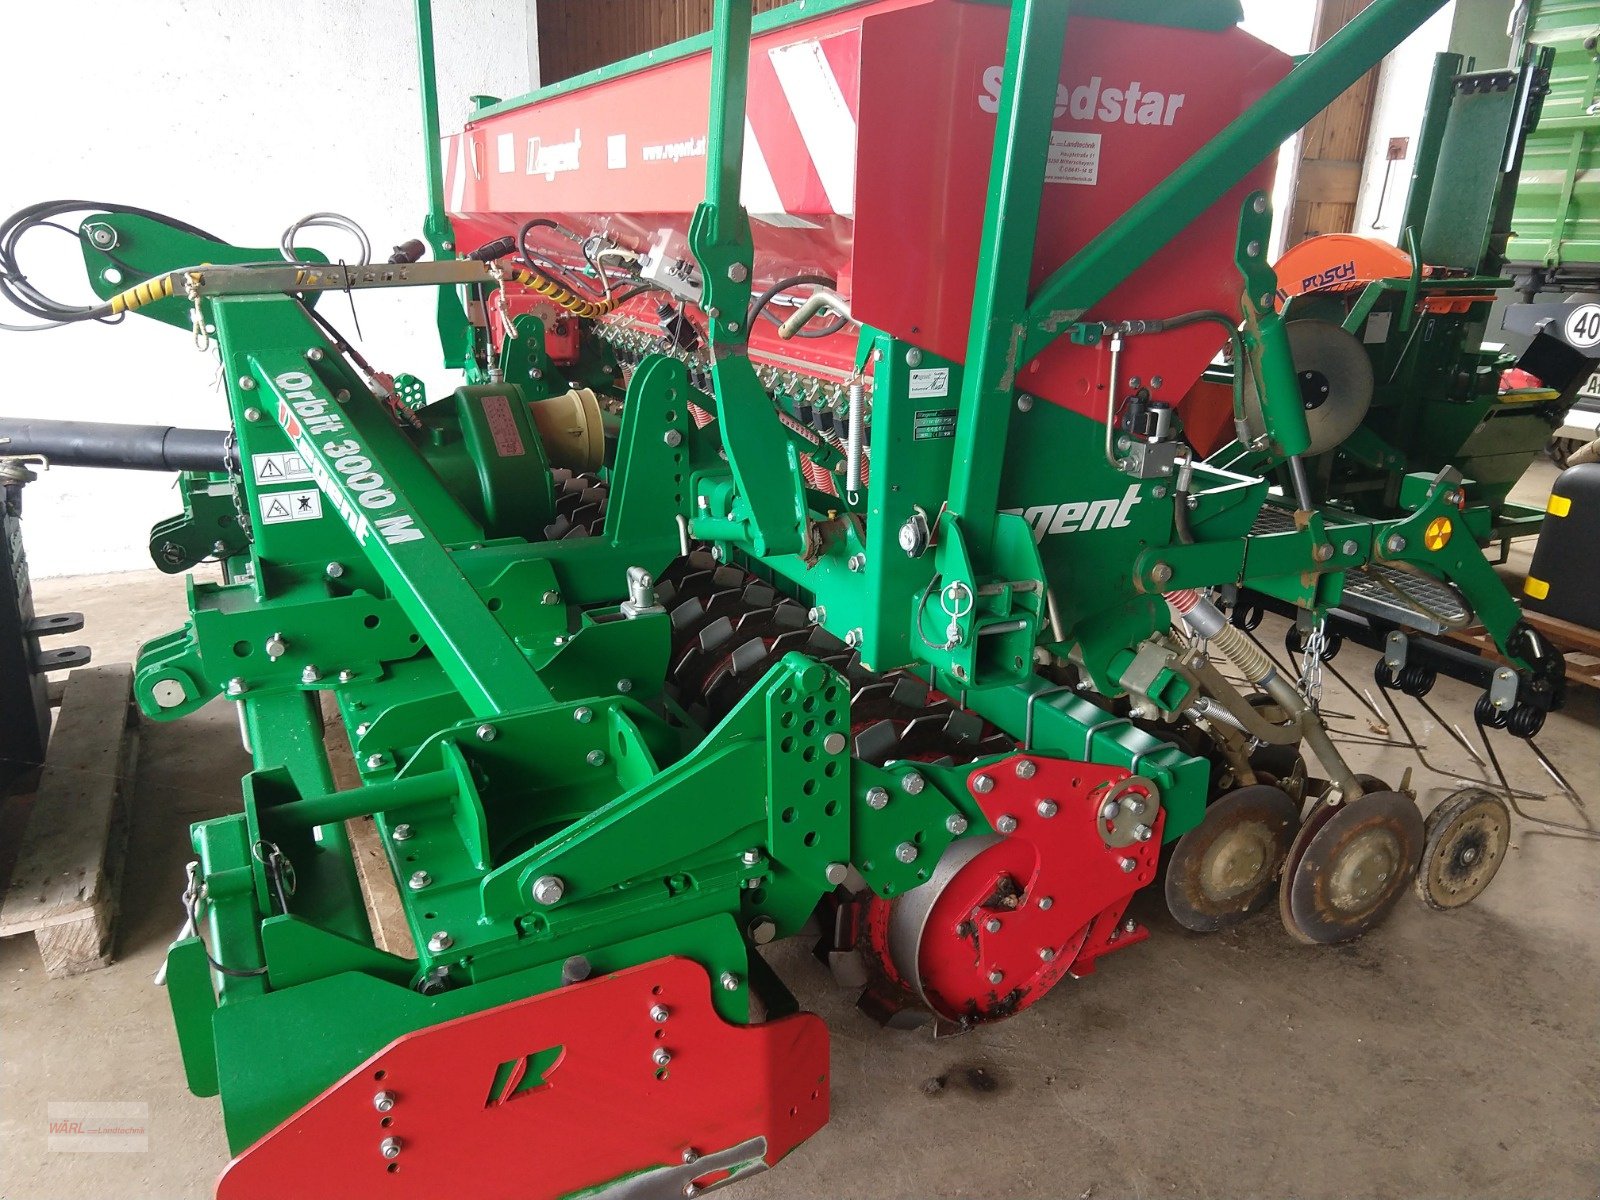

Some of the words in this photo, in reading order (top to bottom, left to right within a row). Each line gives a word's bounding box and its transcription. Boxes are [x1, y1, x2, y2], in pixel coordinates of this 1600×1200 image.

[978, 66, 1185, 126] Sedstar
[1573, 311, 1600, 340] 40
[275, 371, 345, 435] Orbit
[323, 440, 397, 509] 3000
[374, 514, 426, 545] M
[997, 483, 1143, 545] gent
